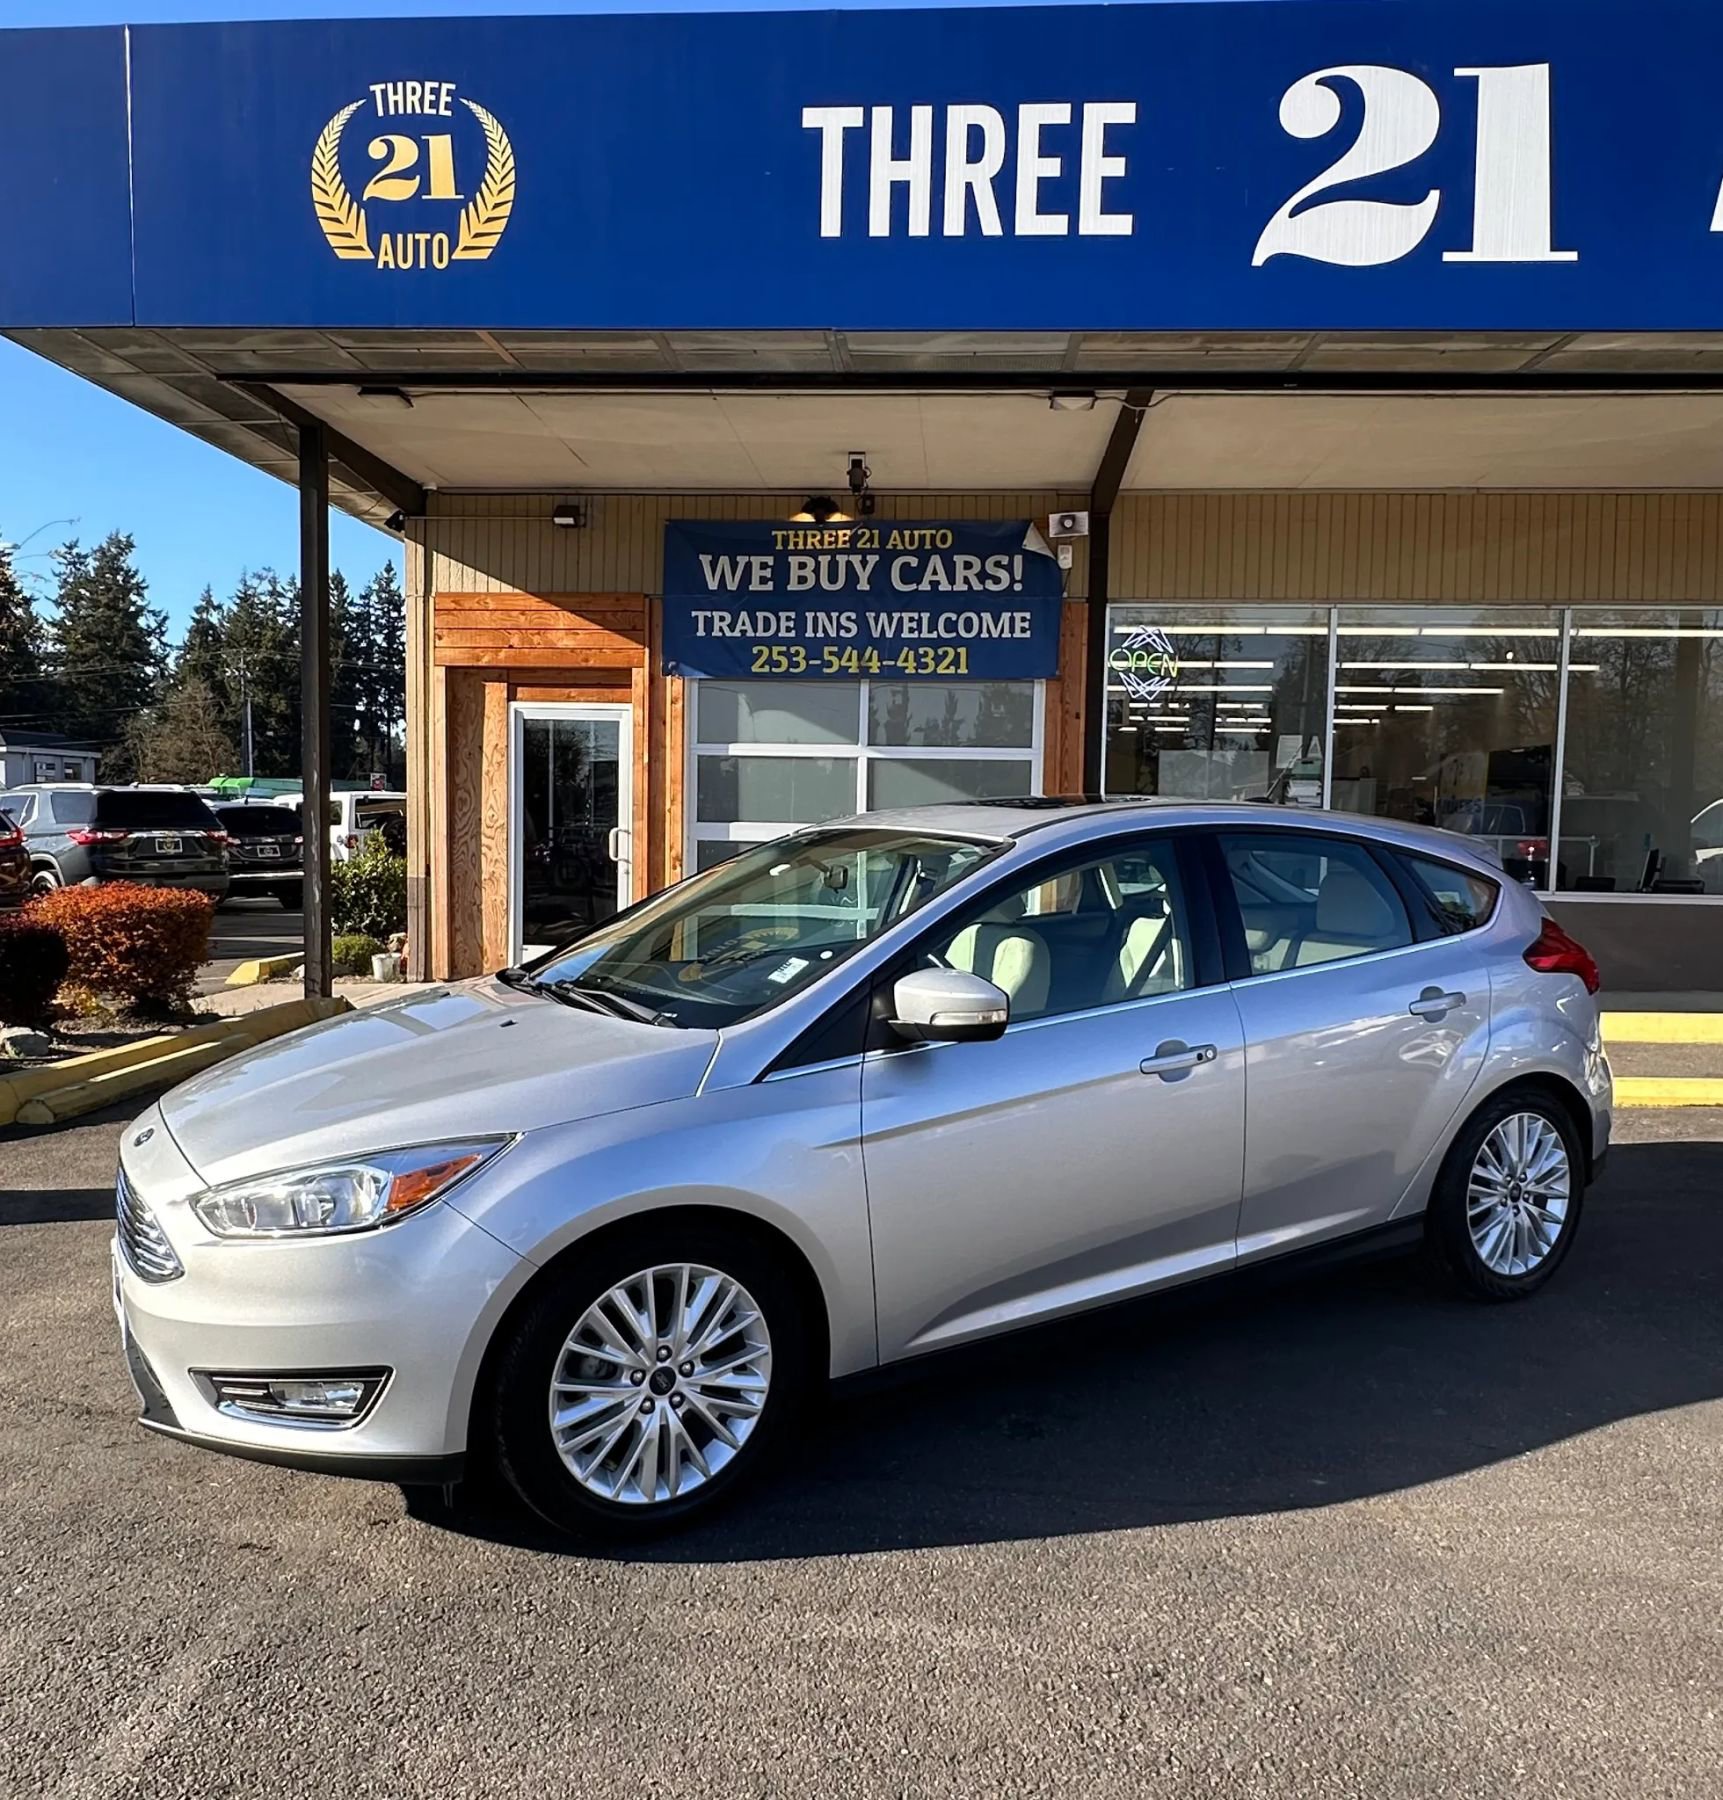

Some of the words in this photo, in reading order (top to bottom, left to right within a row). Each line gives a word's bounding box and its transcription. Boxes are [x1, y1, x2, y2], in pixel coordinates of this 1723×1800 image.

[369, 81, 457, 117] THREE
[363, 134, 465, 202] 21
[801, 102, 1137, 238] THREE
[1251, 62, 1579, 267] 21
[377, 232, 450, 270] AUTO
[771, 529, 852, 550] THREE
[856, 528, 881, 549] 21
[885, 529, 953, 550] AUTO
[699, 553, 775, 592] WE
[786, 553, 881, 592] BUY
[890, 554, 1024, 592] CARS!
[691, 610, 796, 638] TRADE
[804, 611, 858, 638] INS
[865, 611, 1032, 639] WELCOME
[750, 645, 969, 675] 253-544-4321
[1110, 648, 1178, 678] OPEN
